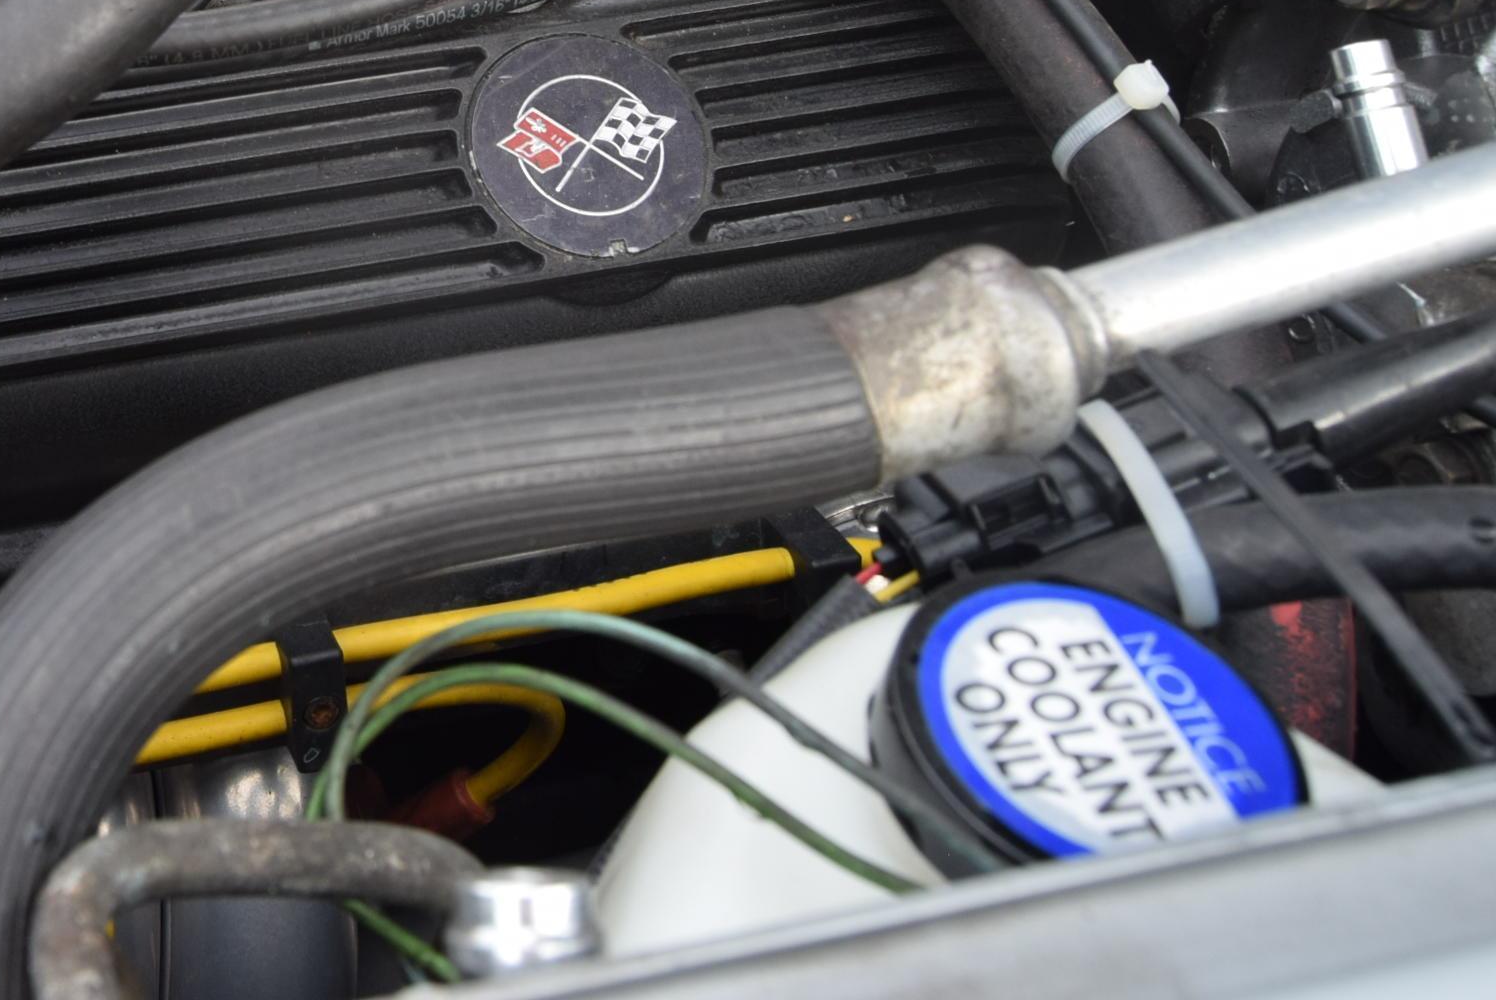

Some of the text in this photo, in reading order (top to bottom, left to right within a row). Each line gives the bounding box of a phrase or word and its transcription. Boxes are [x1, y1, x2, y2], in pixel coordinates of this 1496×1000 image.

[326, 28, 373, 49] Armor
[376, 20, 411, 38] Mark
[415, 6, 466, 29] 50054
[954, 682, 1065, 796] ONLY
[987, 626, 1164, 840] COOLANT
[1060, 639, 1210, 808] ENGINE
[1121, 631, 1268, 797] NOTICE
